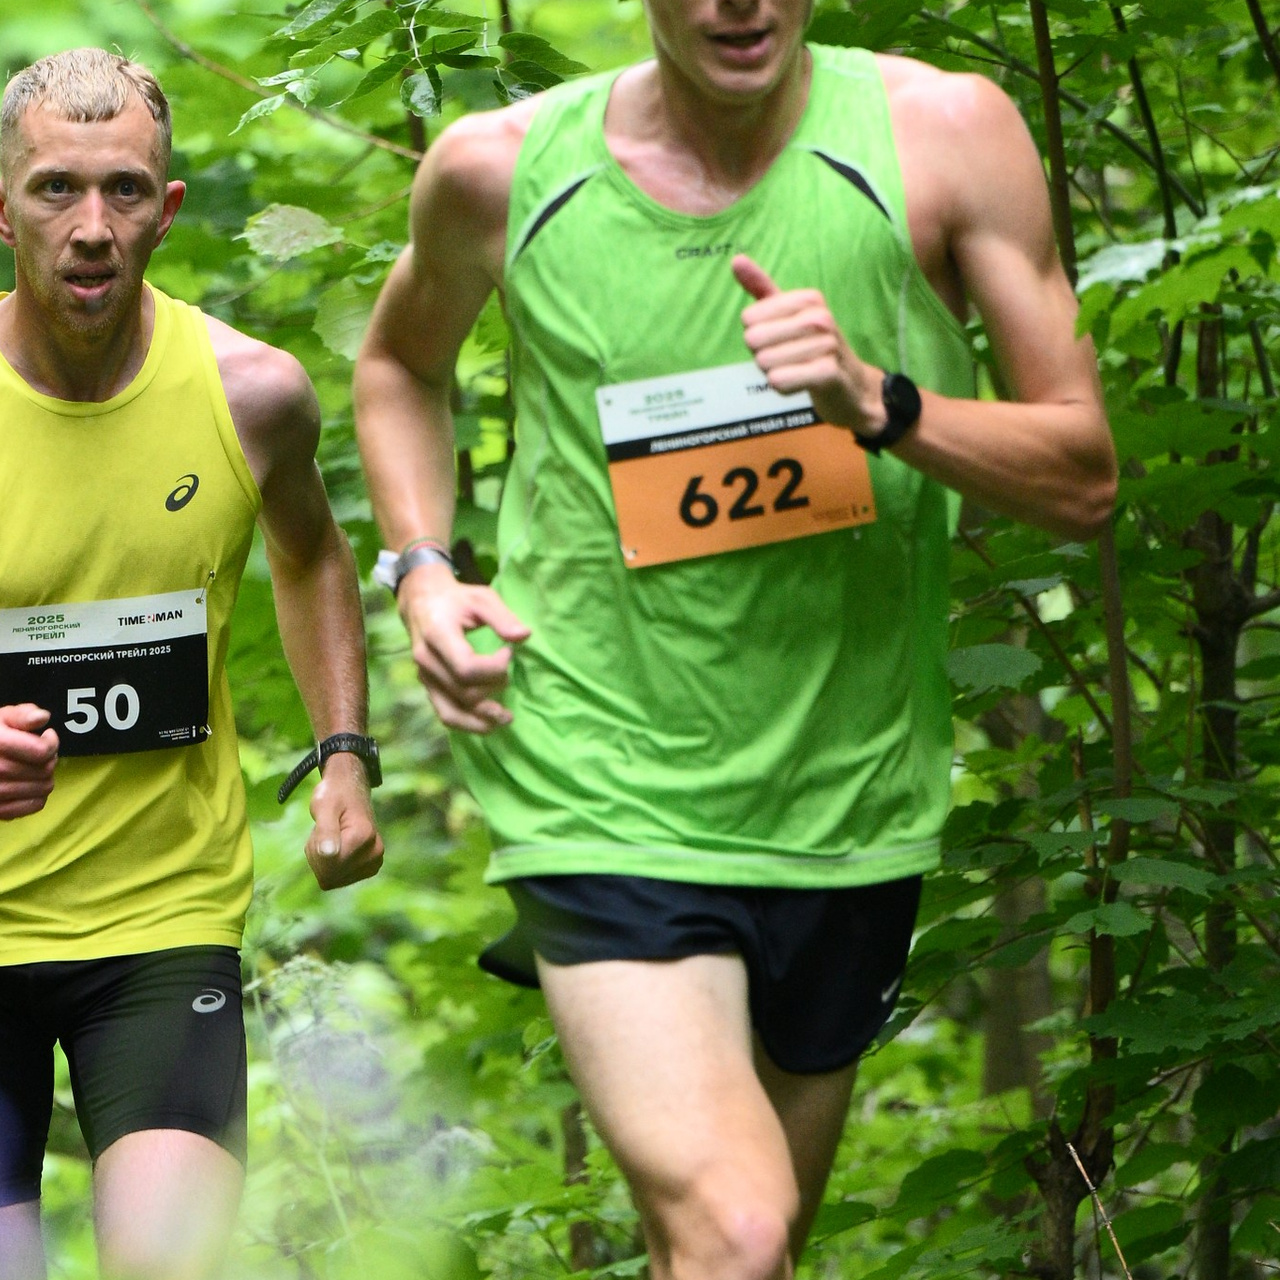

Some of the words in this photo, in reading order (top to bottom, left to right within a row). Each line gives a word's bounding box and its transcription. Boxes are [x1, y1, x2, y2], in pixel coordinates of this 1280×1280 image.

[746, 383, 773, 395] TIM
[679, 458, 810, 529] 622
[27, 614, 65, 625] 2025
[12, 622, 81, 633] ЛЕНИНОГОРСКИЙ
[28, 631, 65, 641] ТРЕЙЛ
[27, 649, 114, 666] ЛЕНИНОГОРСКИЙ
[116, 647, 147, 659] ТРЕЙЛ
[149, 645, 171, 657] 2025
[64, 683, 140, 734] 50
